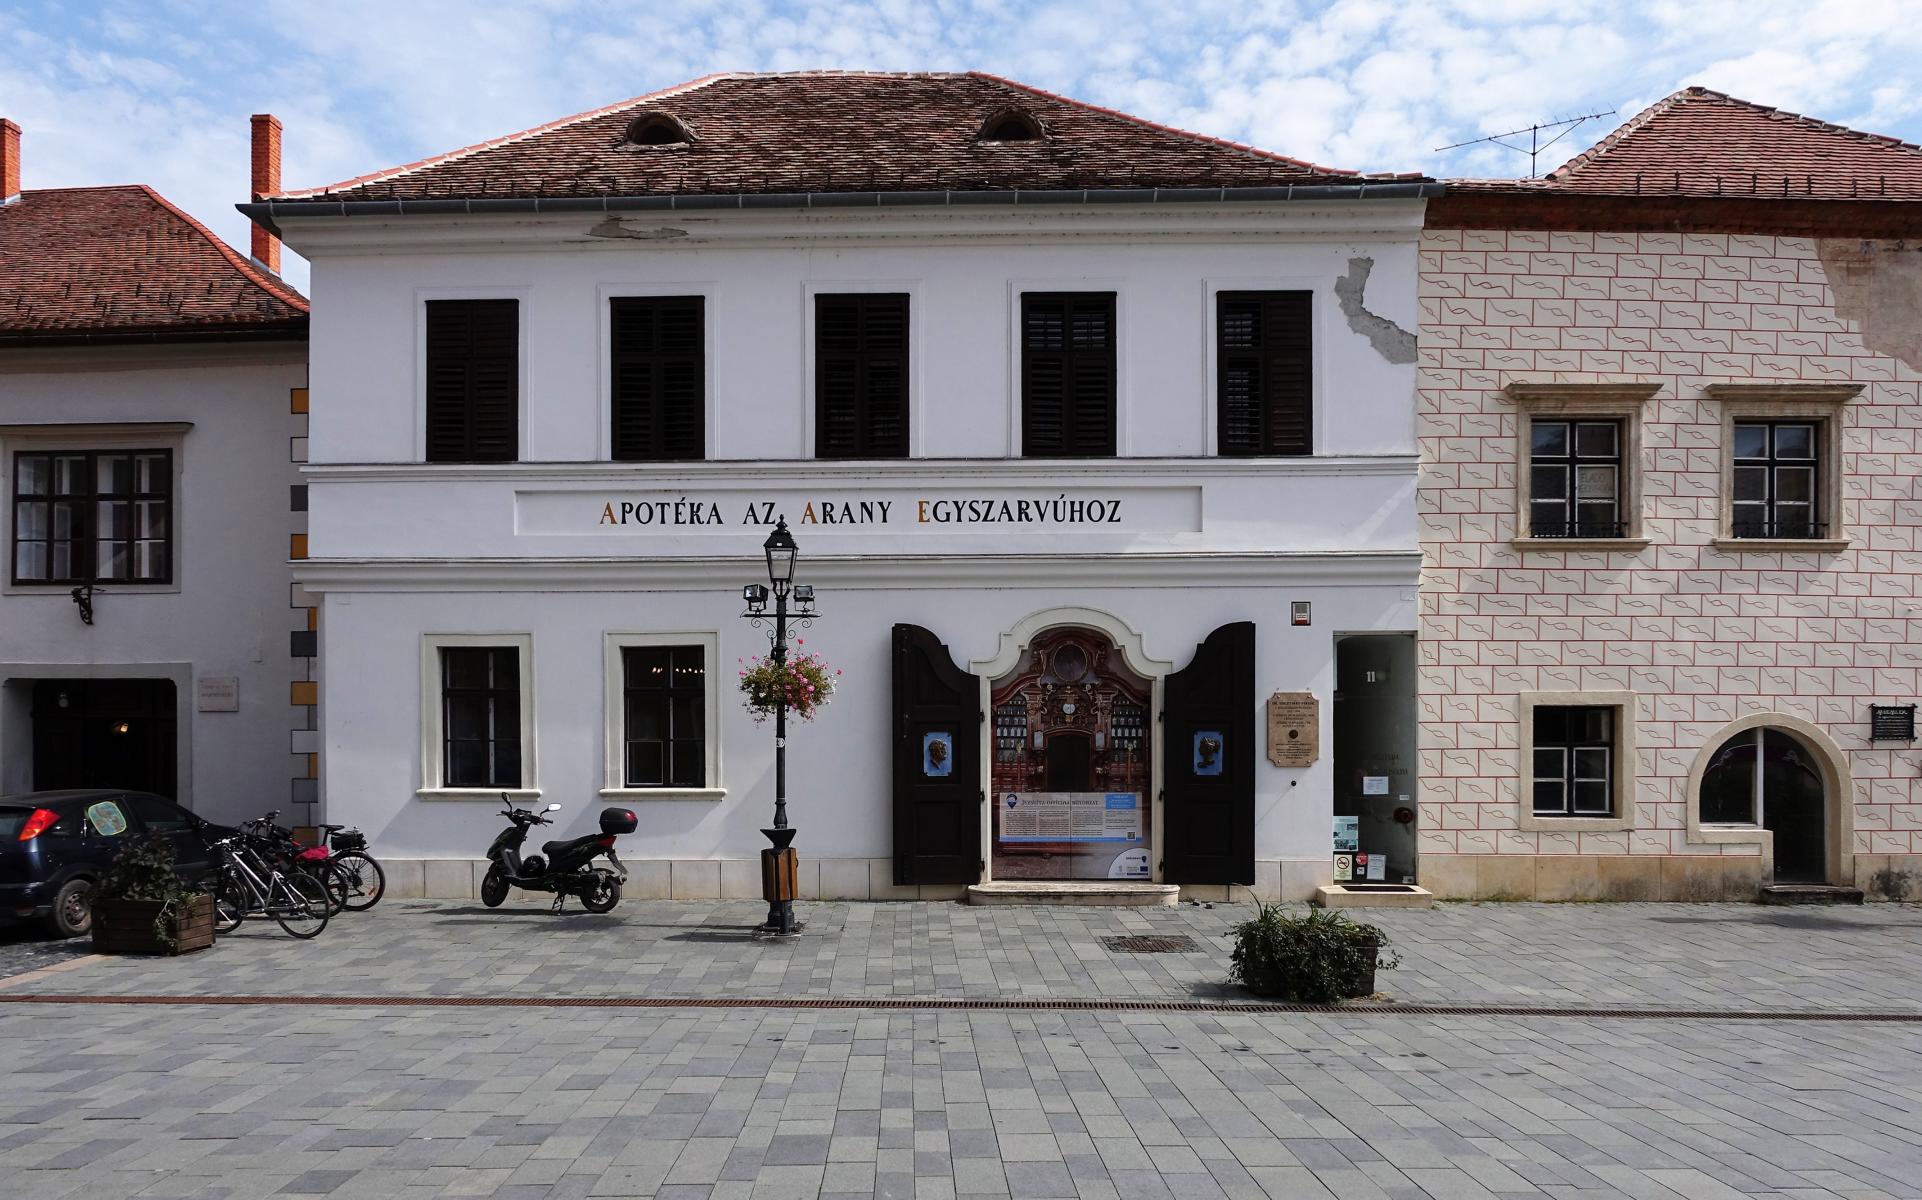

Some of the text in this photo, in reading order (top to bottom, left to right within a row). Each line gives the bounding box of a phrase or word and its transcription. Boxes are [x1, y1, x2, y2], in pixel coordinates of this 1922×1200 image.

[600, 494, 1122, 525] APOTÉKA AZ ARANY EGYSZARVÚHOZ
[1366, 671, 1376, 682] 11
